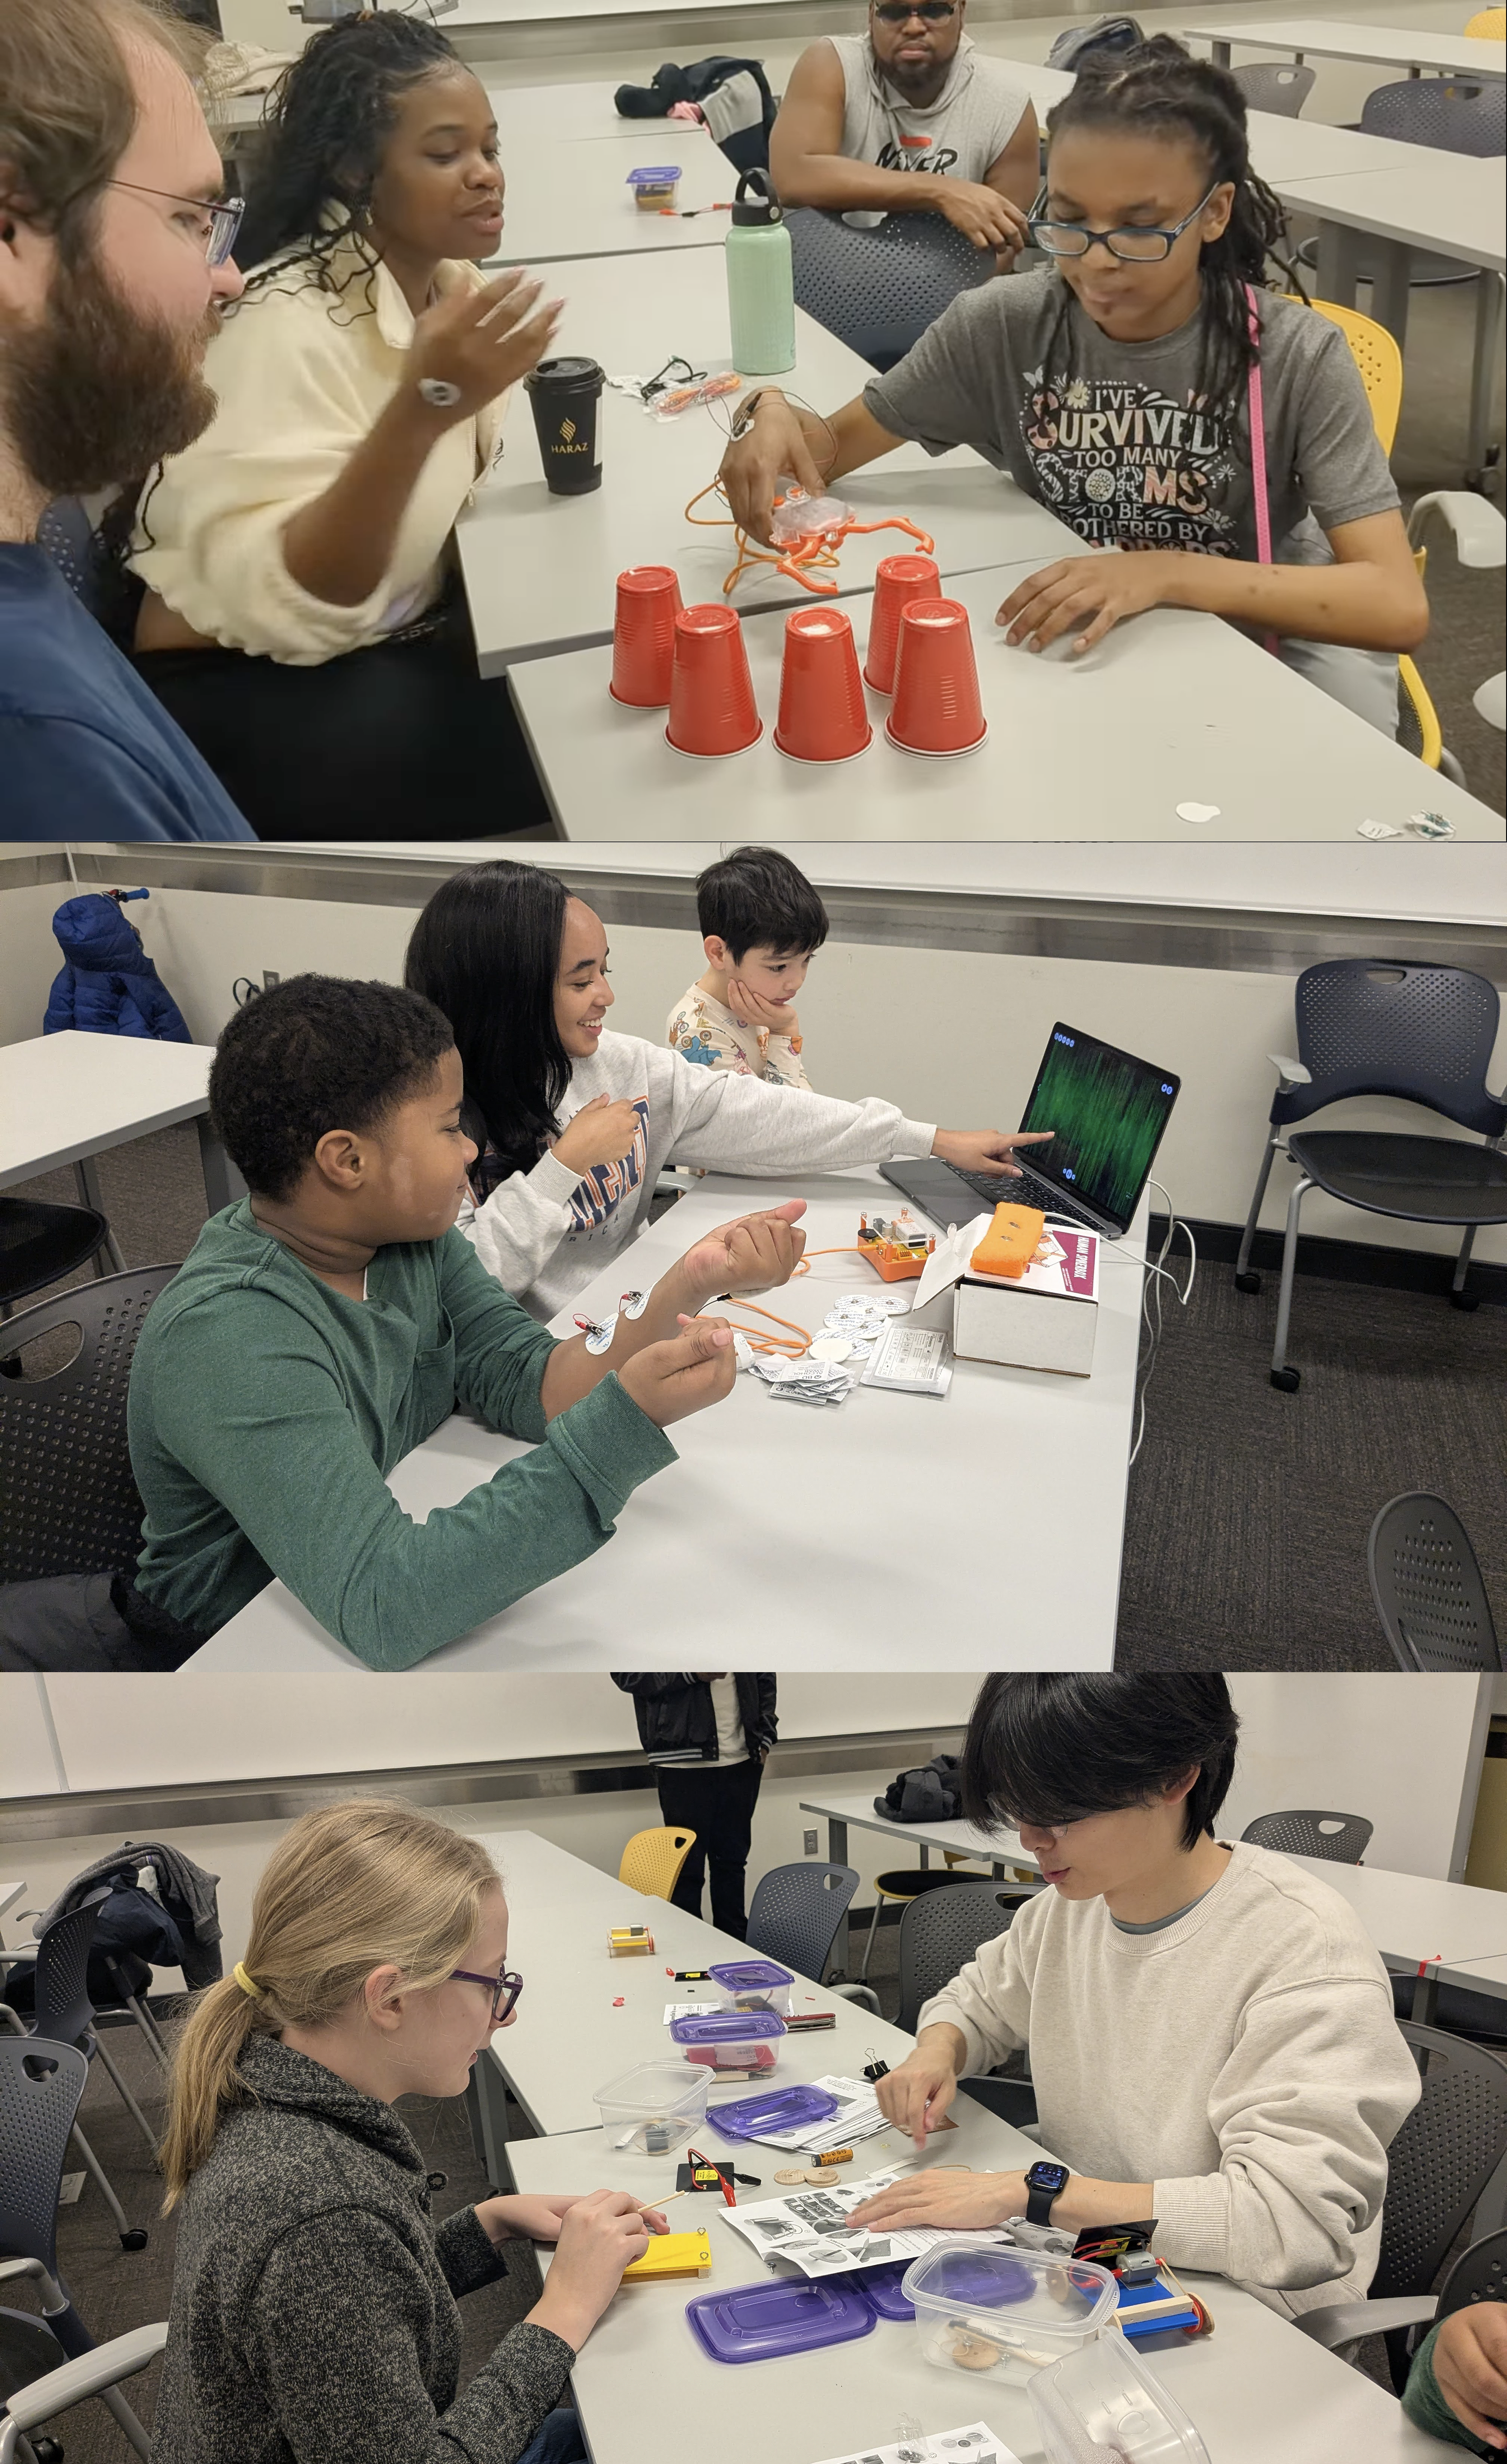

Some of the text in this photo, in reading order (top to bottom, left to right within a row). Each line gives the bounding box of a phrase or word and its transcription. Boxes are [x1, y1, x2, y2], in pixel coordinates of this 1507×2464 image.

[1096, 389, 1137, 411] I'VE
[551, 442, 588, 454] HARAZ
[1073, 446, 1182, 468] TOO MANY
[1035, 453, 1209, 514] STORMS
[1088, 503, 1144, 520] TO BE
[1178, 522, 1209, 541] BY
[1074, 1236, 1089, 1279] HUMAN SPIKERBOX
